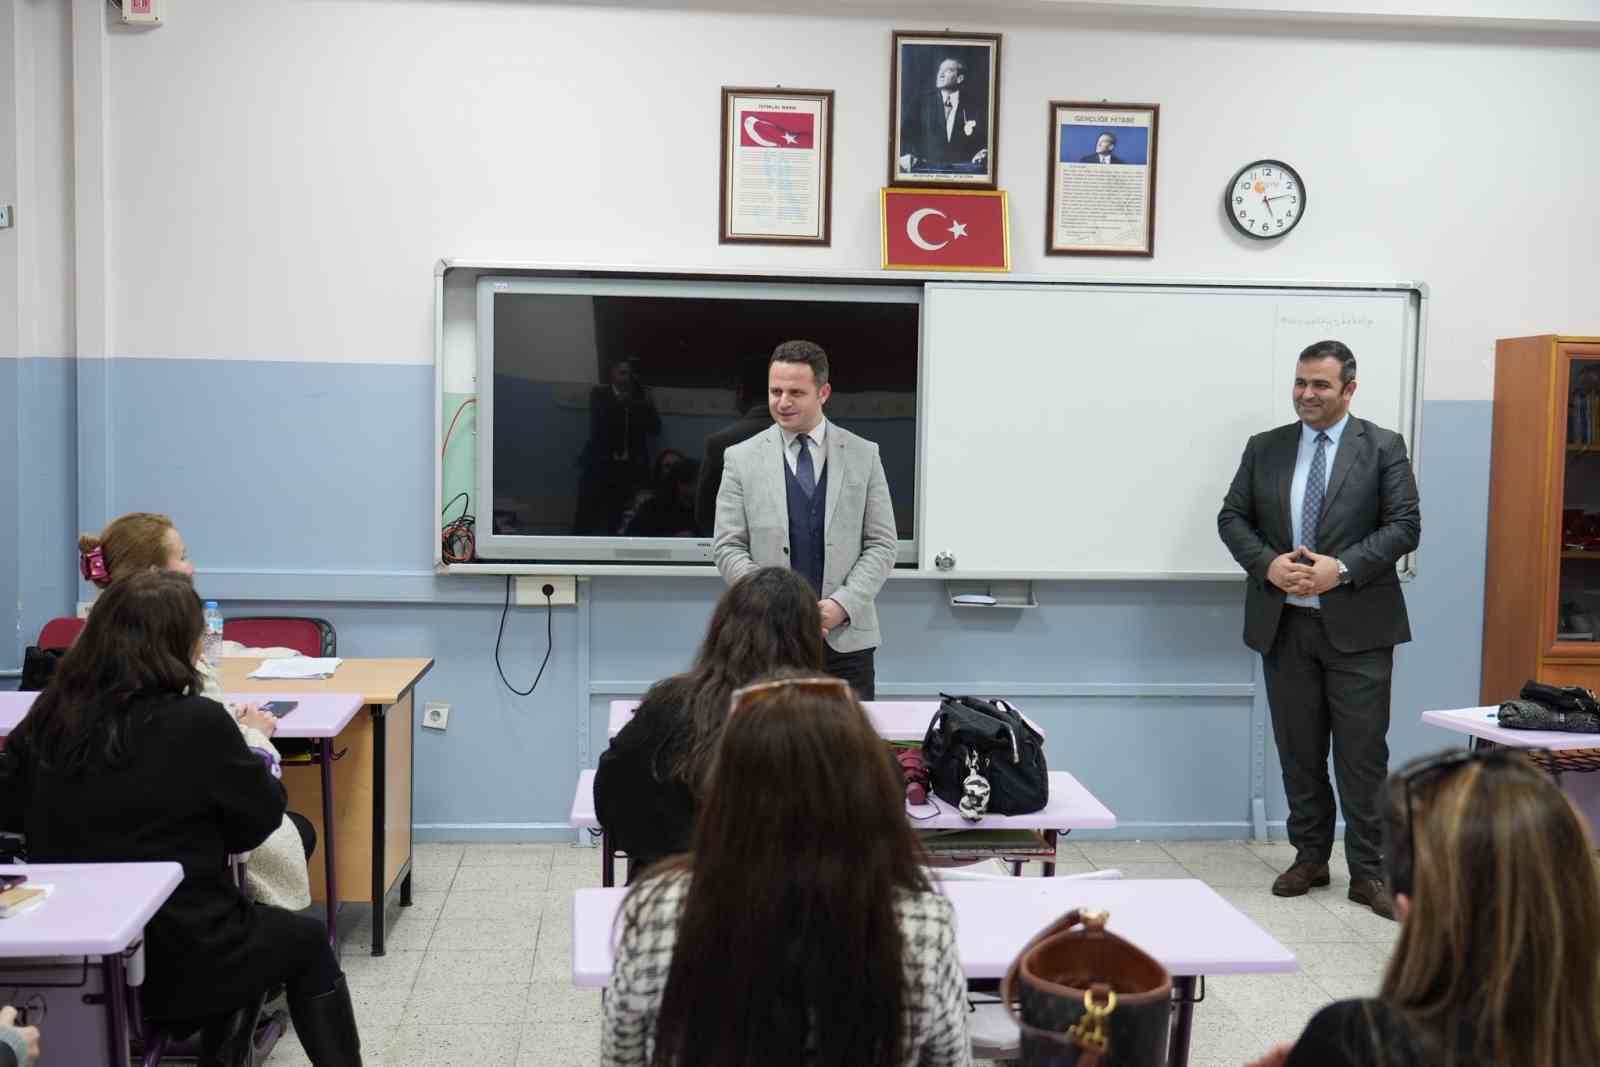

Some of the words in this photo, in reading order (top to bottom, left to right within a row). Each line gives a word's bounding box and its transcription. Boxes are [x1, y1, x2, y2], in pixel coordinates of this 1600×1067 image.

[1263, 168, 1272, 176] 12
[1241, 182, 1251, 190] 10
[1286, 181, 1294, 190] 2
[1236, 196, 1243, 205] 9
[1290, 195, 1297, 204] 3
[1240, 210, 1247, 218] 8
[1286, 209, 1292, 217] 4
[1248, 219, 1255, 228] 7
[1262, 222, 1270, 231] 6
[1277, 219, 1283, 228] 5
